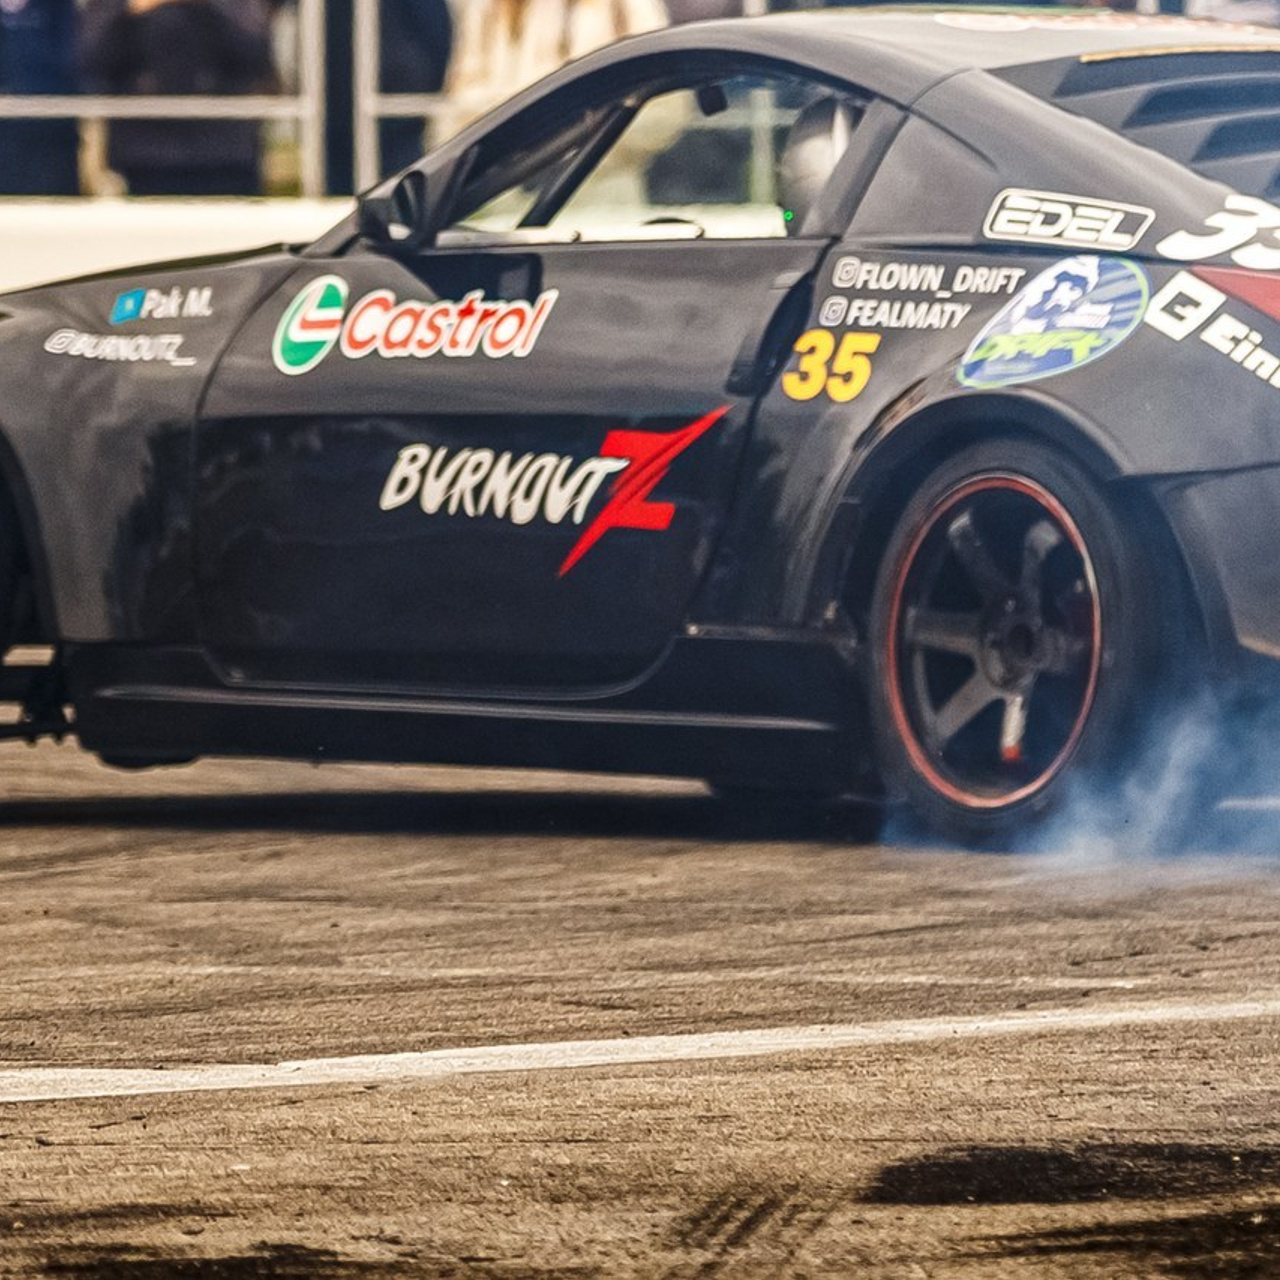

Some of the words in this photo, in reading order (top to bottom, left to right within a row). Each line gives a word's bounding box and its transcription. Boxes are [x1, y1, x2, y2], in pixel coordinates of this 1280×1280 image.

[990, 195, 1142, 248] EDEL
[340, 287, 560, 358] Castrol
[781, 329, 882, 403] 35
